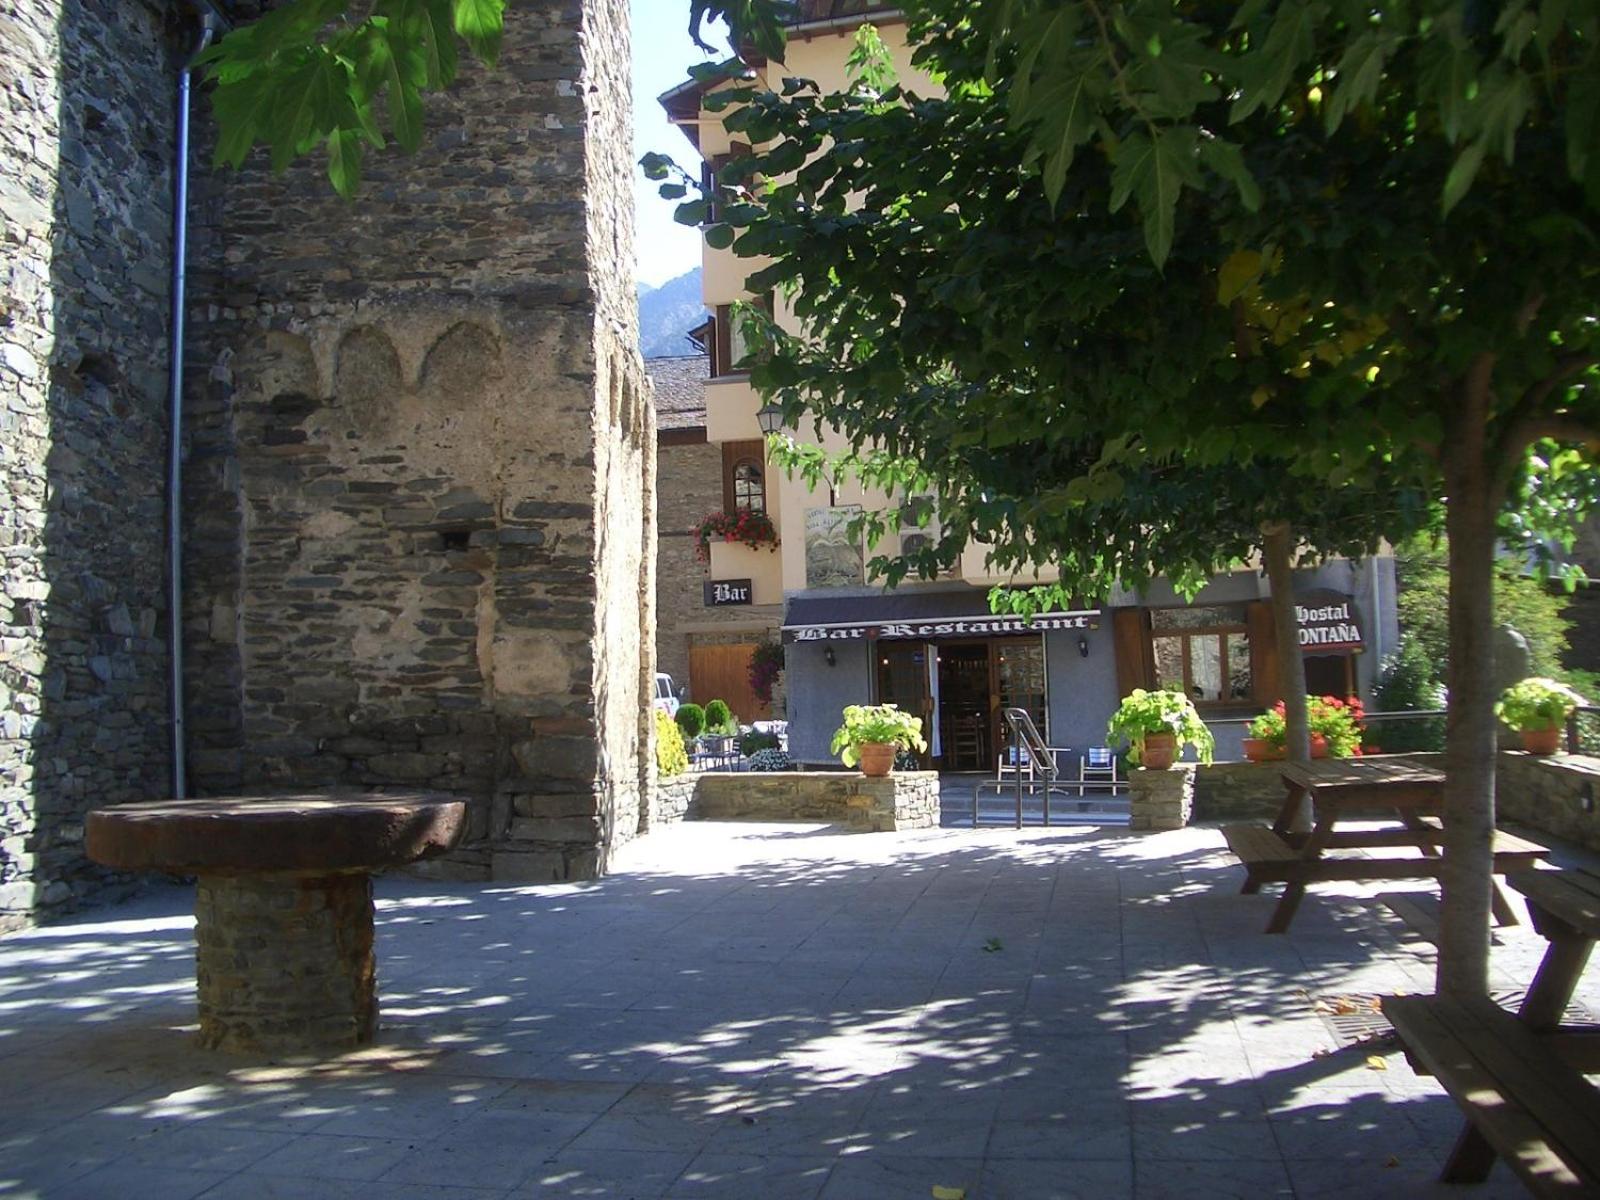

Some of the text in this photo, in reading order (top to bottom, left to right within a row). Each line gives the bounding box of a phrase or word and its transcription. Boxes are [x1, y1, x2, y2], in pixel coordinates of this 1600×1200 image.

[713, 584, 747, 604] Bar
[1294, 603, 1350, 625] Hostal
[793, 616, 1089, 642] Bar Restaurant
[1298, 622, 1361, 645] ONTAÑA
